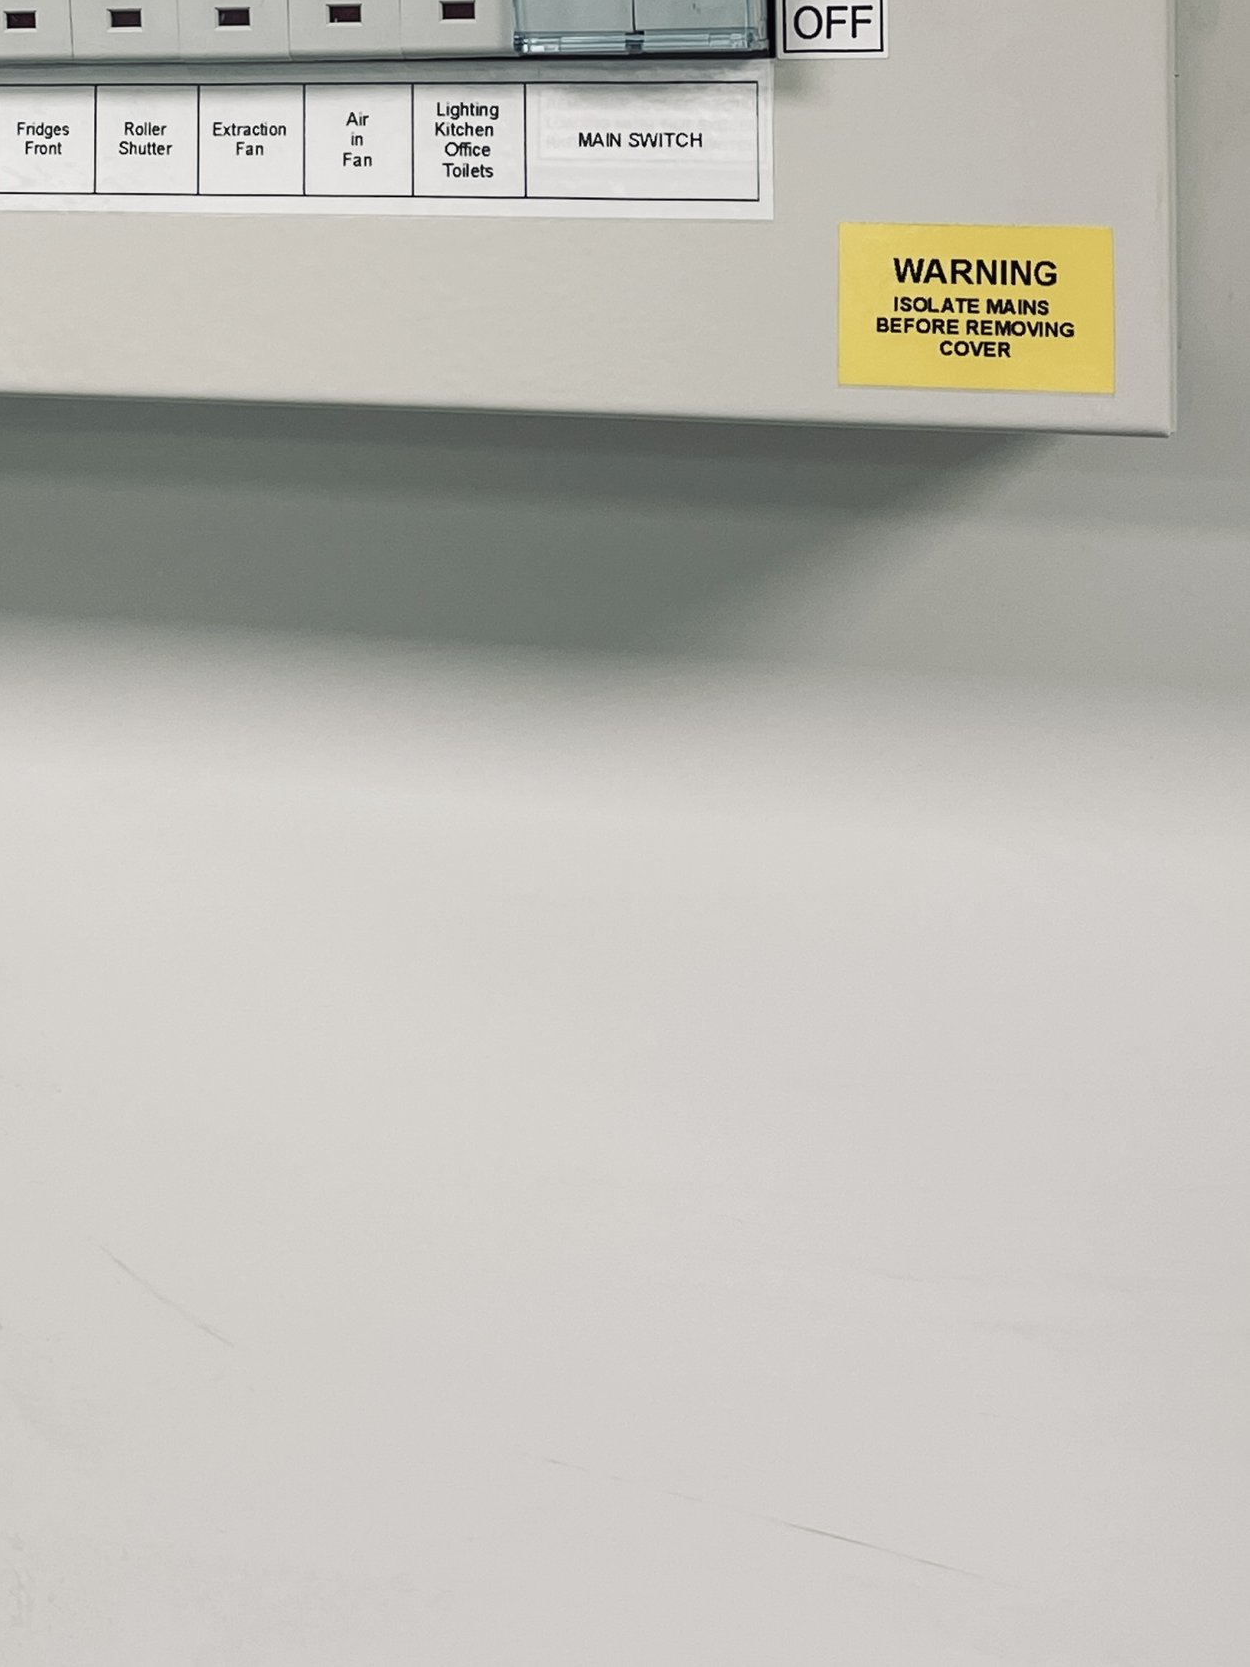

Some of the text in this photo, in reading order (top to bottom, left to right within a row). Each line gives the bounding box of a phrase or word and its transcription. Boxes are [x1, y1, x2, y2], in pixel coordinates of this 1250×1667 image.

[793, 4, 873, 40] OFF
[436, 102, 499, 120] Lighting
[346, 112, 369, 127] Air
[17, 122, 70, 139] Fridges
[124, 122, 167, 136] Roller
[212, 122, 287, 137] Extraction
[434, 122, 494, 137] Kitchen
[351, 132, 363, 146] in
[578, 132, 703, 148] MAIN SWITCH
[25, 141, 62, 155] Front
[118, 141, 173, 155] Shutter
[236, 142, 264, 156] Fan
[445, 142, 491, 157] Office
[343, 153, 372, 167] Fan
[442, 163, 493, 178] Toilets
[893, 257, 1057, 286] WARNING
[894, 296, 1049, 316] ISOLATE MAINS
[876, 317, 1074, 338] BEFORE REMOVING
[939, 340, 1011, 358] COVER
